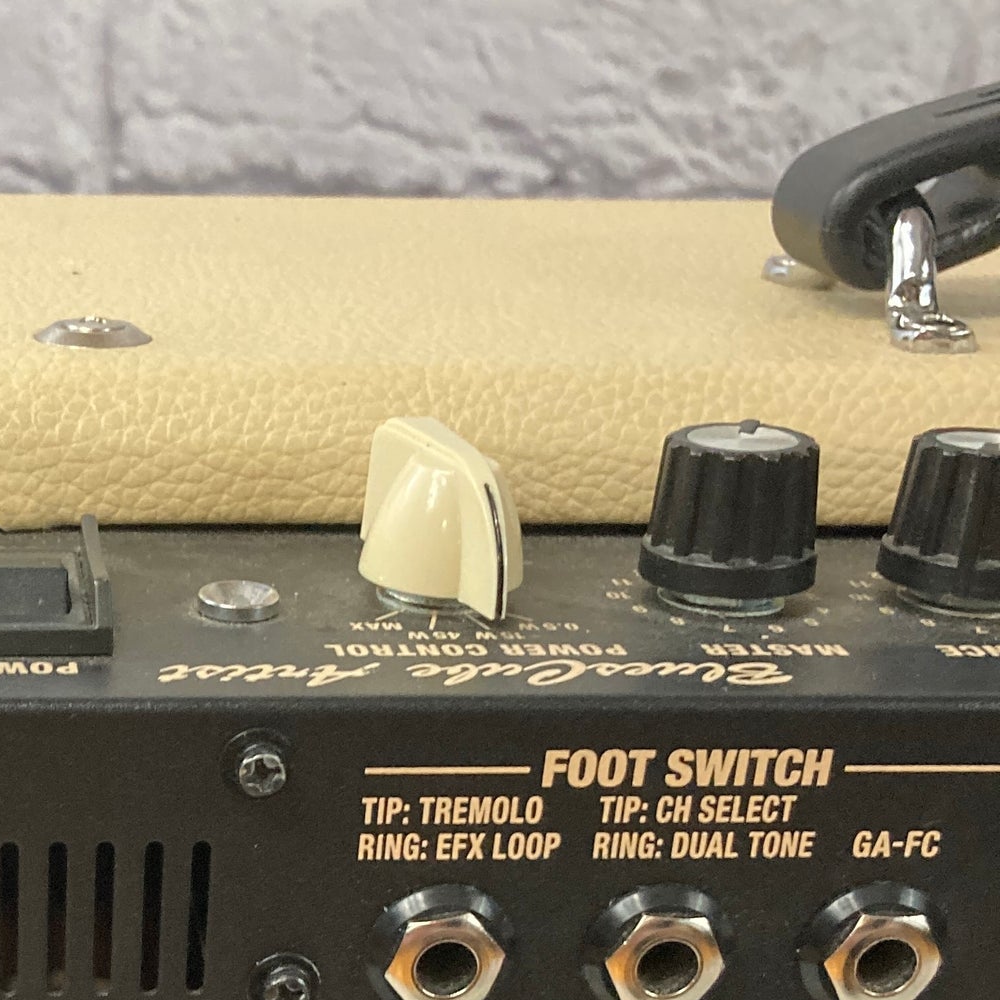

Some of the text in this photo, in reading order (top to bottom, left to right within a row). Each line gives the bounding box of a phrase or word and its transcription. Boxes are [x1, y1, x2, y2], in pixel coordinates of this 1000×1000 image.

[349, 621, 403, 631] MAX
[324, 643, 628, 657] POWER CONTROL
[700, 643, 850, 657] MASTER
[158, 661, 381, 688] Artist
[541, 747, 834, 788] FOOT SWITCH
[361, 795, 545, 826] TIP: TREMOLO
[599, 794, 798, 824] TIP: CH SELECT
[357, 830, 562, 861] RING: EFX LOOP
[592, 830, 816, 860] RING: DUAL TONE
[852, 829, 942, 858] GA-FC
